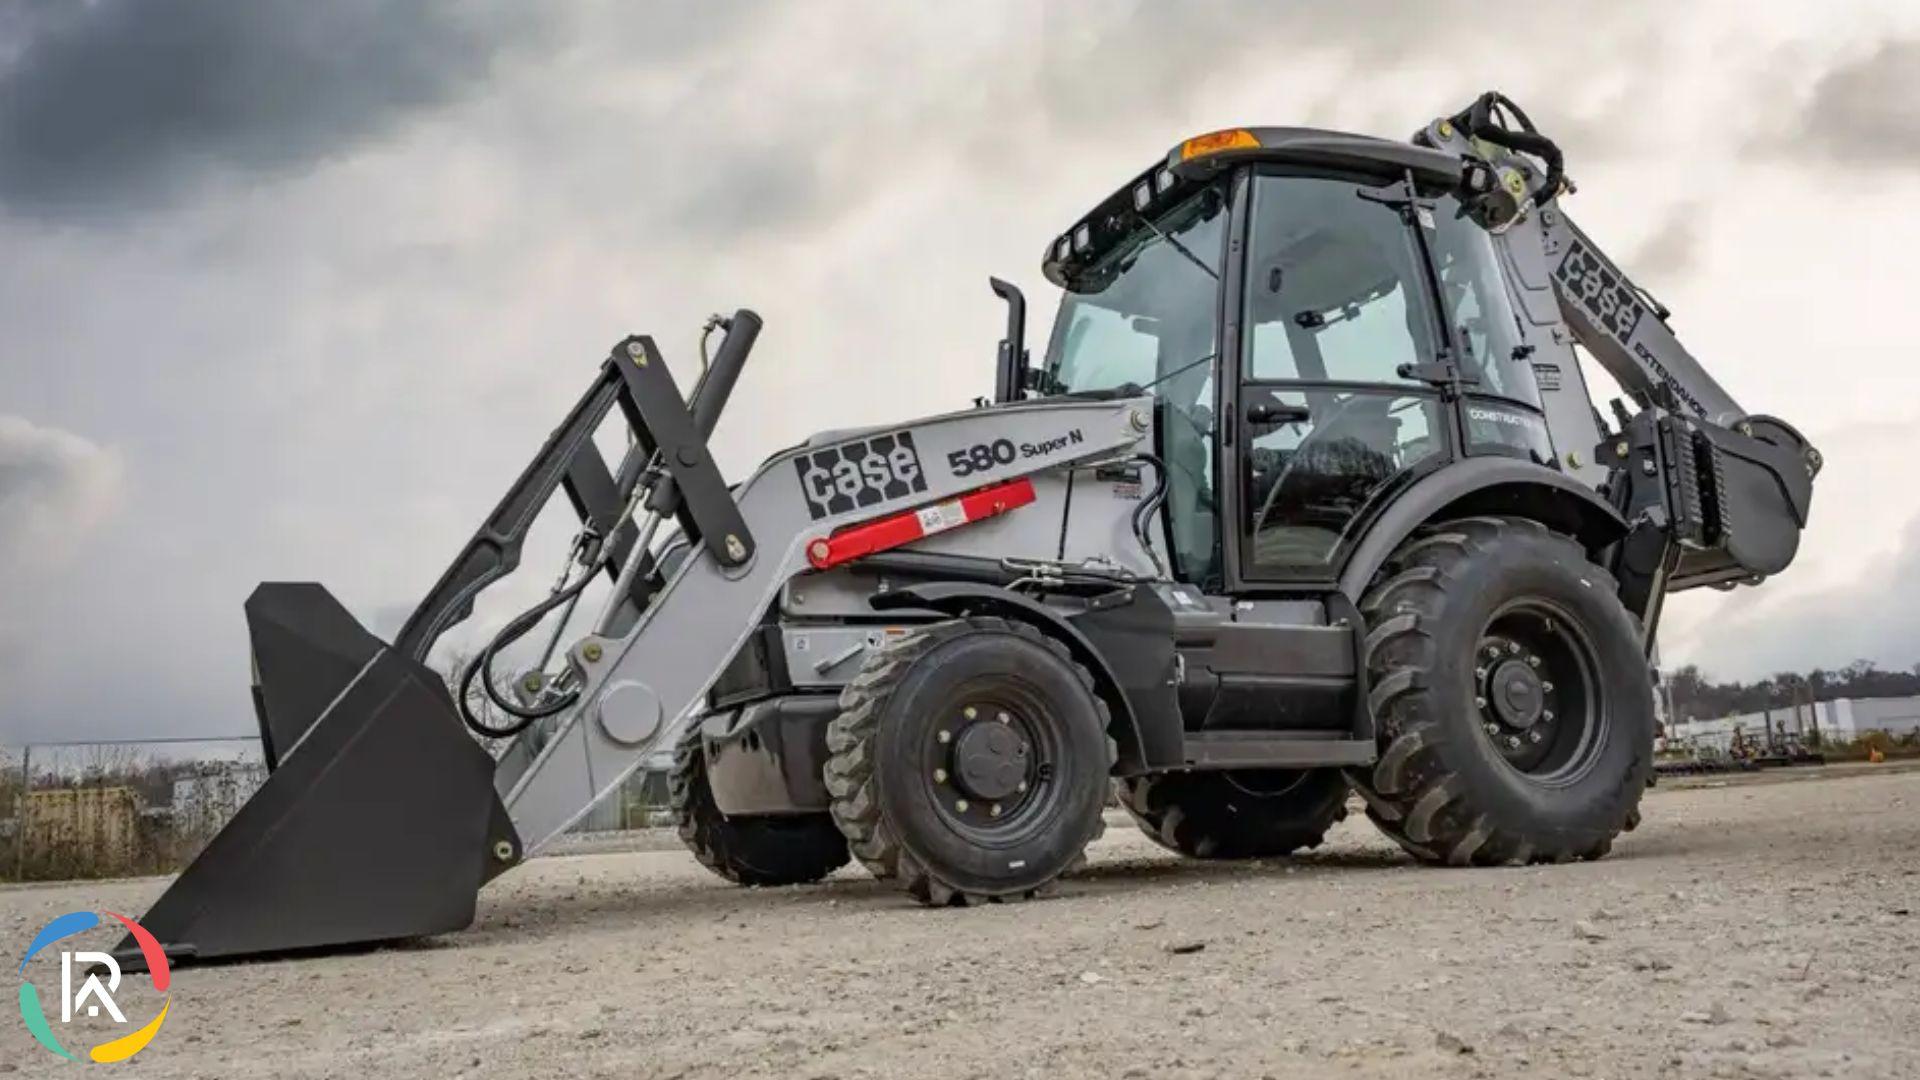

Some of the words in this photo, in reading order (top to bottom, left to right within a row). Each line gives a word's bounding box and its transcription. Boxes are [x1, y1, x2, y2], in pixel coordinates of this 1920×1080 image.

[796, 434, 925, 516] case
[947, 438, 1016, 477] 580
[1020, 435, 1068, 458] Super
[1069, 428, 1084, 444] N
